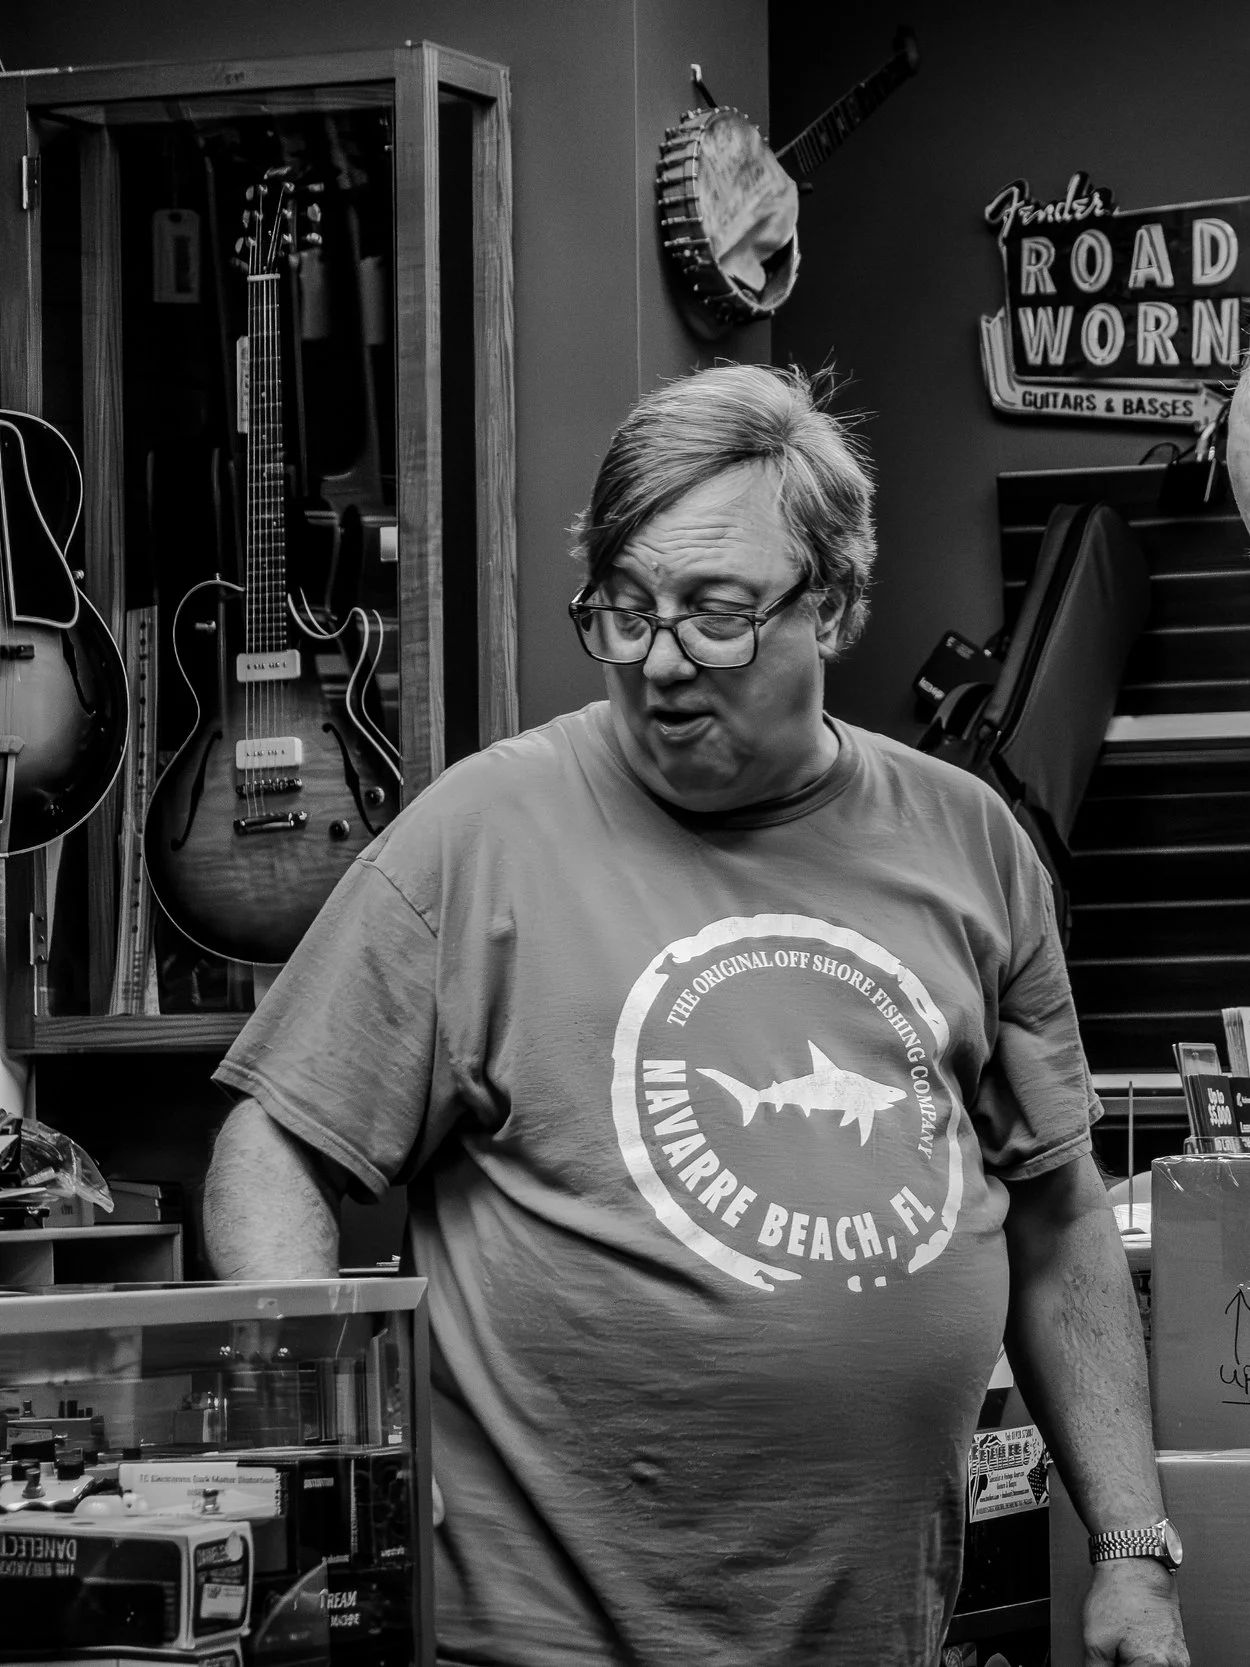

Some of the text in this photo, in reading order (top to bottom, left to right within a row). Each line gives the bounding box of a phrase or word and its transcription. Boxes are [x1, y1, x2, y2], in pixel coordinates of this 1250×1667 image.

[985, 172, 1105, 238] Fender
[1020, 218, 1239, 296] ROAD
[1018, 297, 1241, 367] WORN
[1021, 390, 1194, 418] GUITARS & BASSES
[667, 950, 937, 1160] THE ORIGINAL OFF SHORE FISHING COMPANY
[642, 1059, 936, 1261] NAVARRE BEACH, FL
